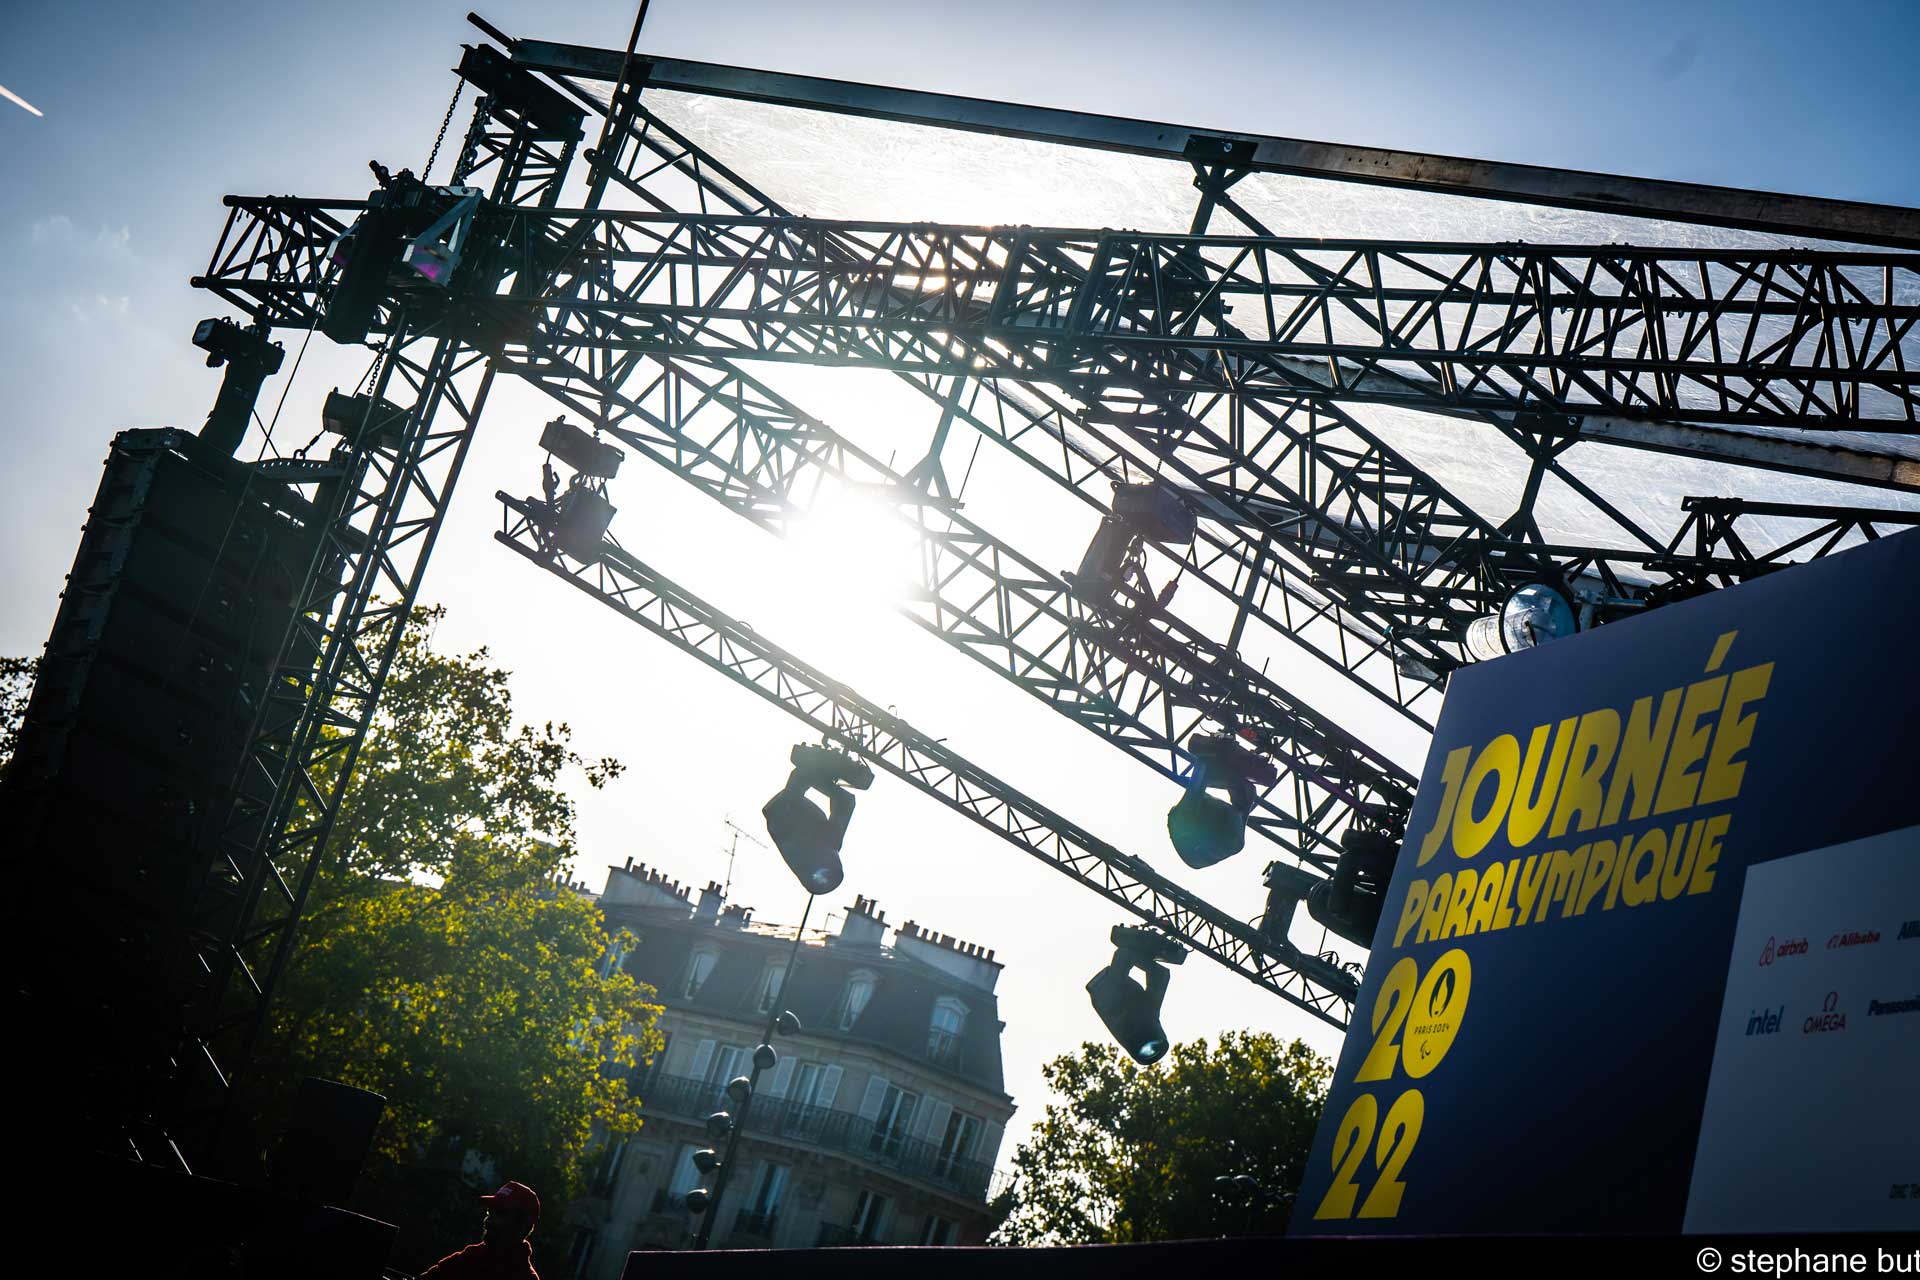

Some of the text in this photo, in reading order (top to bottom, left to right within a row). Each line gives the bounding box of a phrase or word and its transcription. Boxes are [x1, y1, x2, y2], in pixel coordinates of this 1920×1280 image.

[1417, 630, 1775, 866] JOURNÉE
[1393, 813, 1731, 947] PARALYMPIQUE
[1776, 937, 1809, 957] airbnb
[1838, 930, 1881, 948] Alibaba
[1414, 1022, 1451, 1035] PARIS 2024
[1746, 1005, 1785, 1036] intel
[1803, 1013, 1846, 1034] OMEGA
[1313, 1088, 1425, 1220] 22
